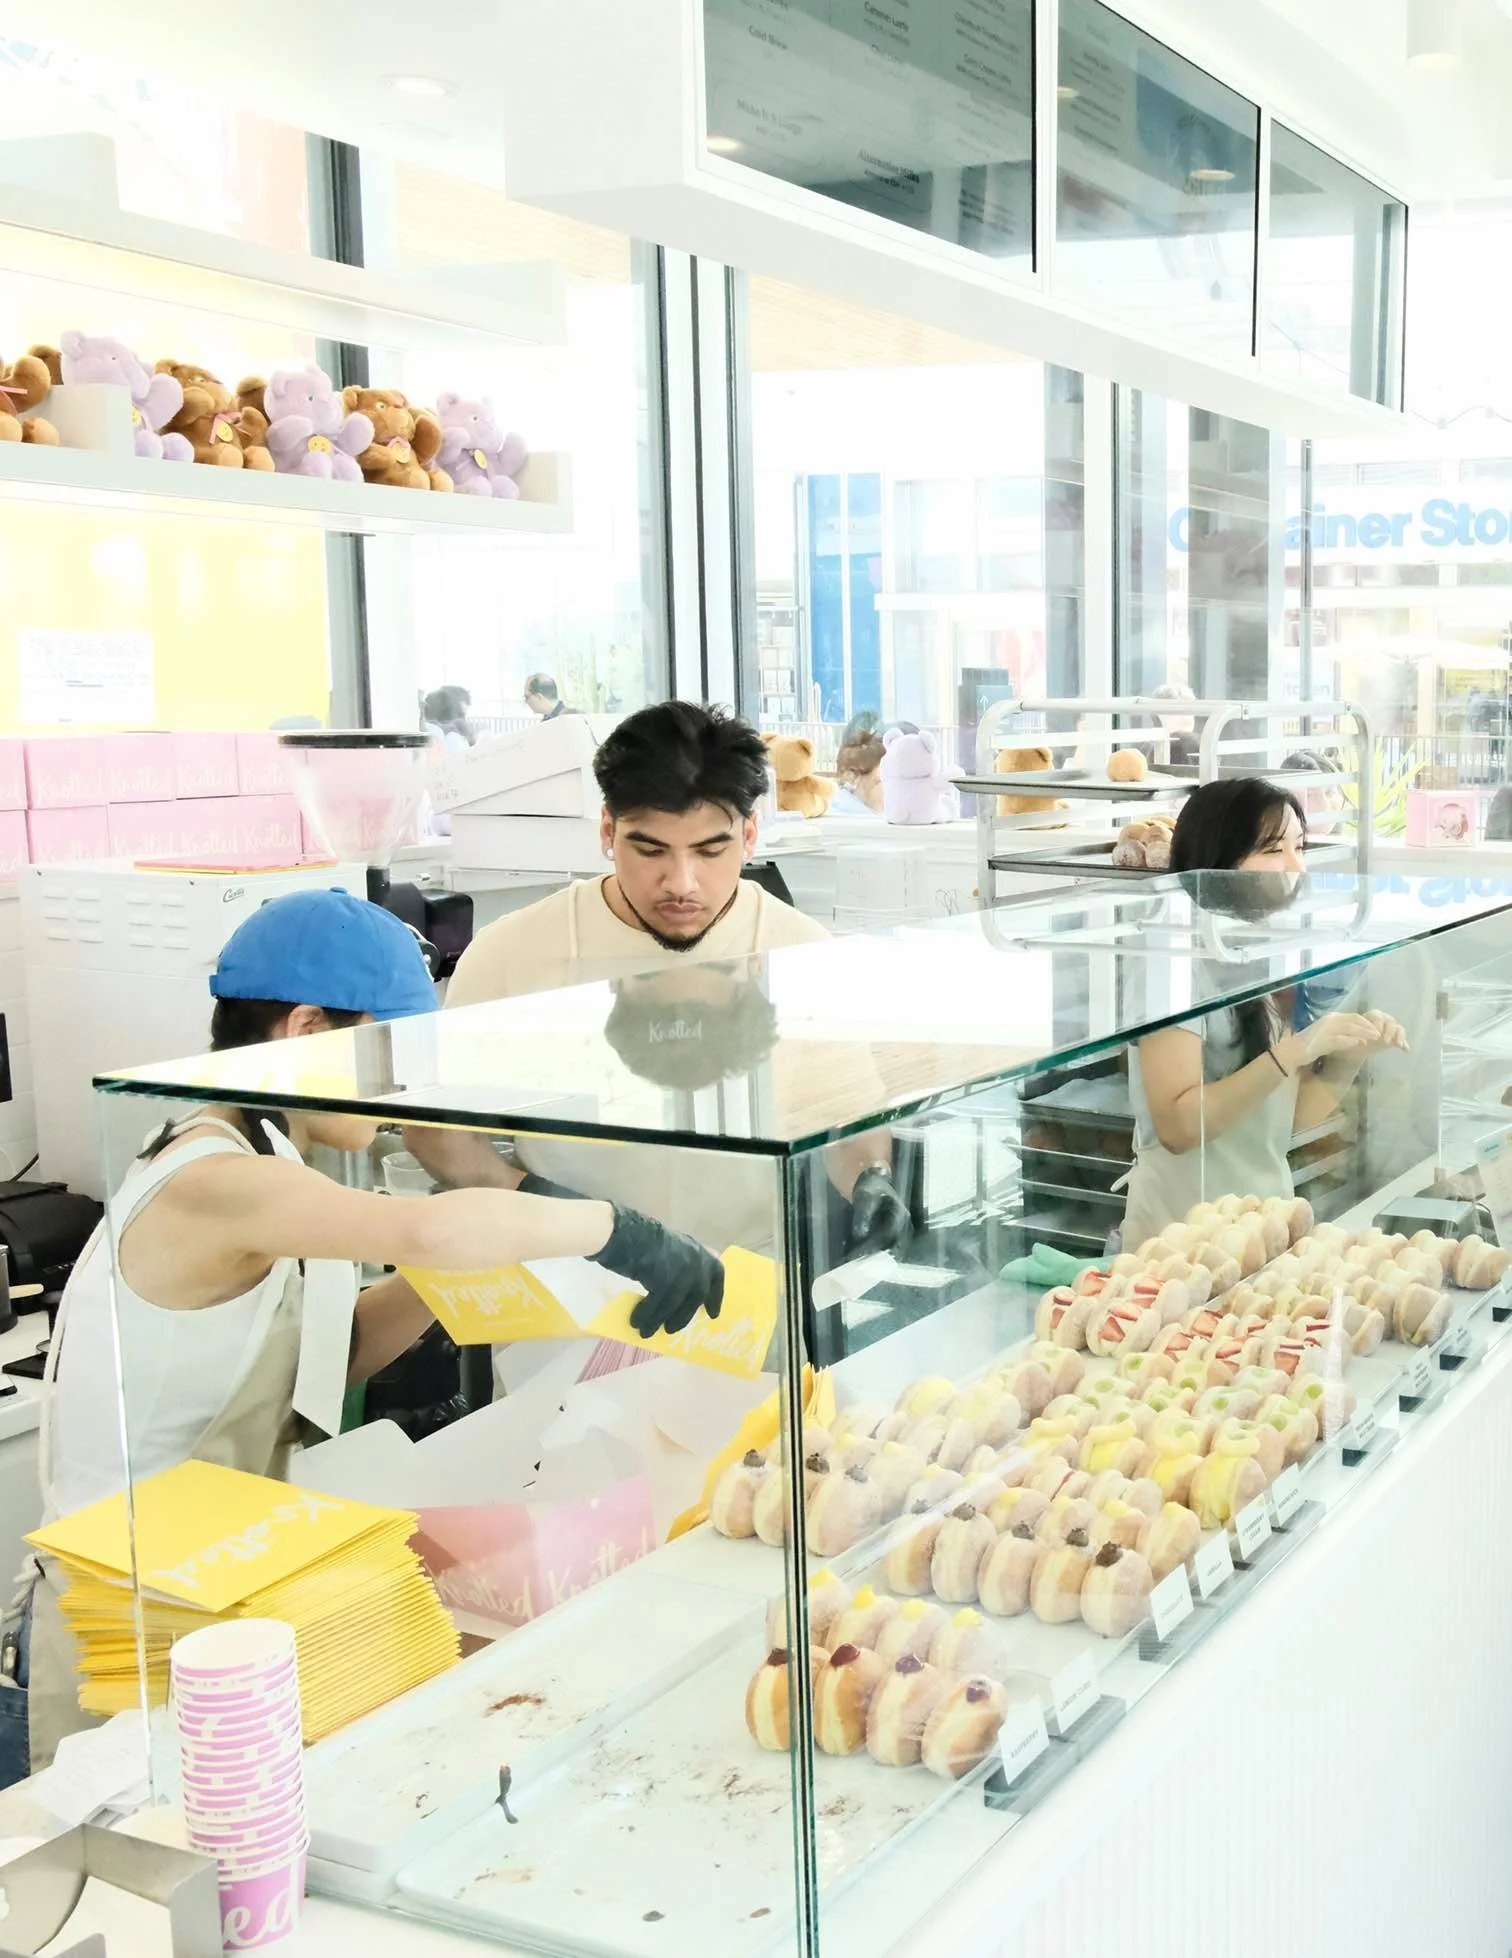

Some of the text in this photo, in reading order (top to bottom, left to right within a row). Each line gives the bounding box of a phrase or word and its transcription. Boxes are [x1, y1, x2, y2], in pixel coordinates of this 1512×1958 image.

[1421, 498, 1512, 547] Sto
[648, 1018, 703, 1044] Knotted
[150, 1493, 345, 1589] Knotted
